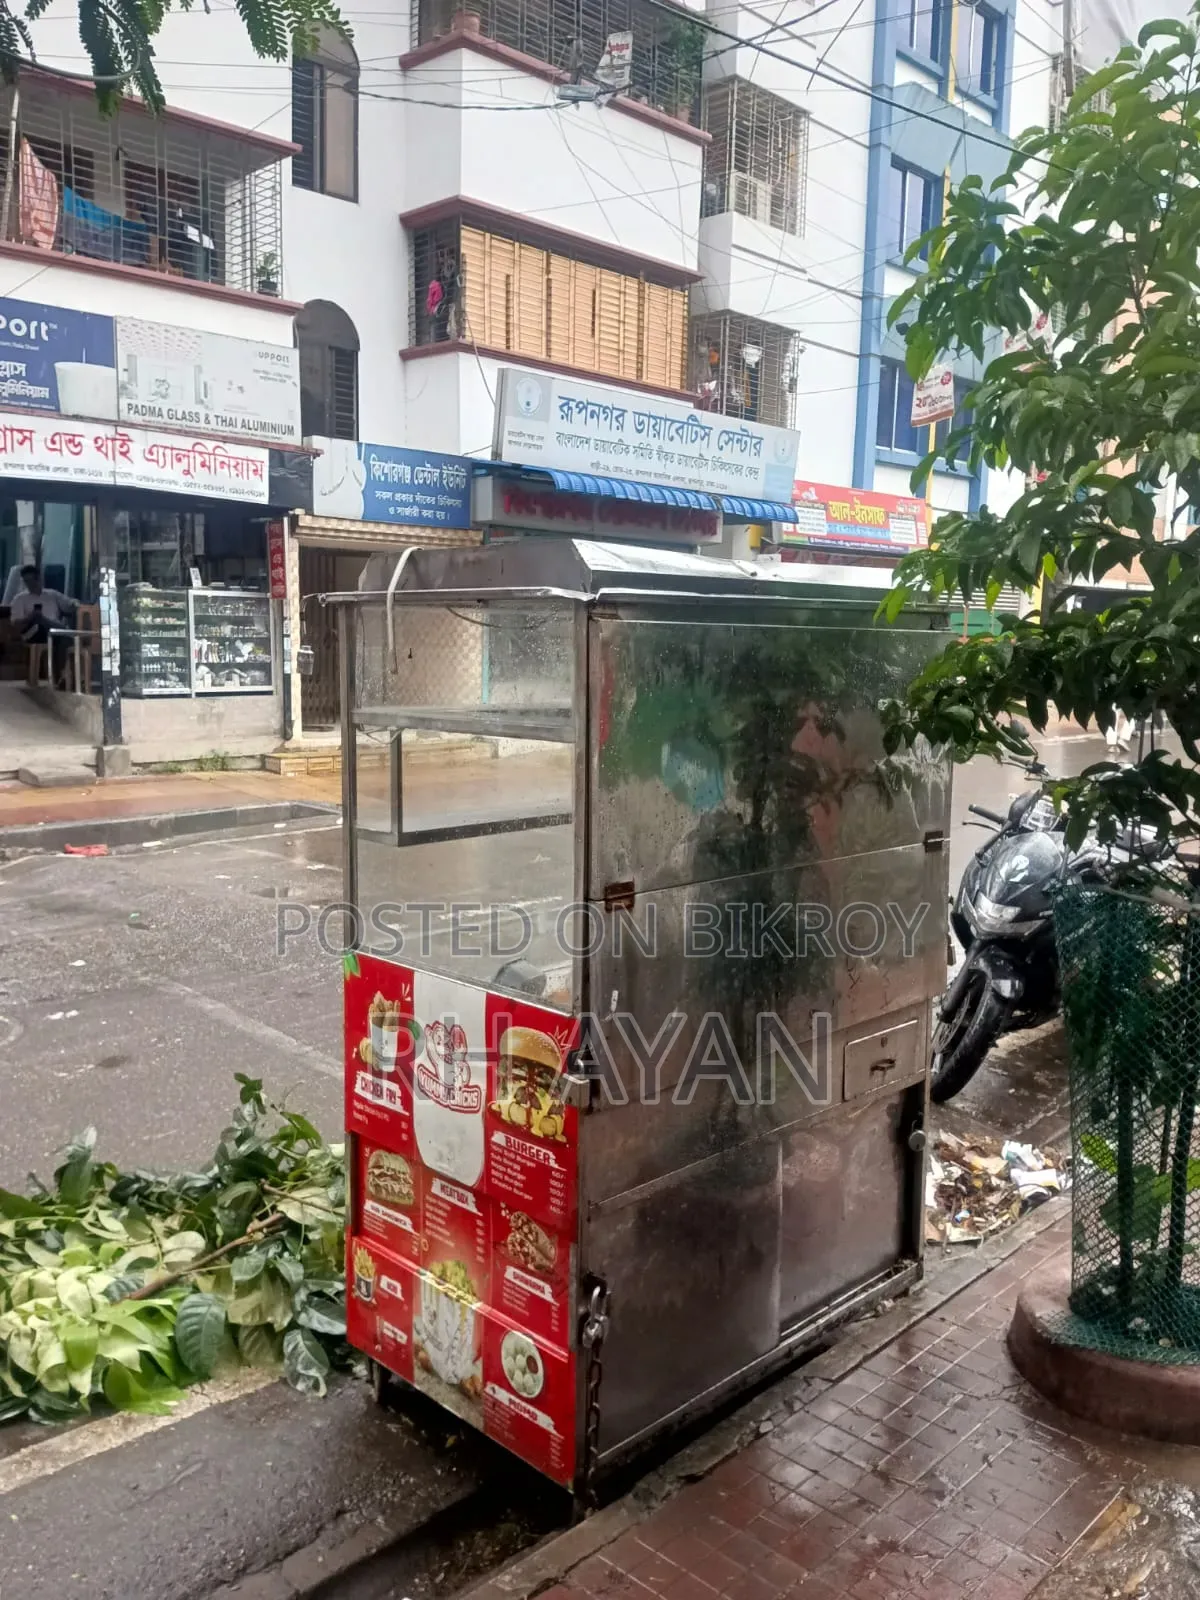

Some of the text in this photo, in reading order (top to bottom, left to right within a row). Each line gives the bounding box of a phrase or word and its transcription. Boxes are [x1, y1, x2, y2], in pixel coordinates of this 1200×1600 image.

[127, 402, 164, 419] PADMA
[167, 408, 201, 425] GLASS
[203, 414, 211, 425] &
[214, 414, 238, 429] THAI
[240, 418, 295, 437] ALUMINIUM
[557, 395, 764, 459] রূপনগর ডায়াবেটিস সেন্টার
[44, 432, 85, 457] এন্ড
[93, 431, 135, 464] থাই
[555, 431, 591, 452] বাংলাদেশ
[504, 1135, 551, 1166] BURGER
